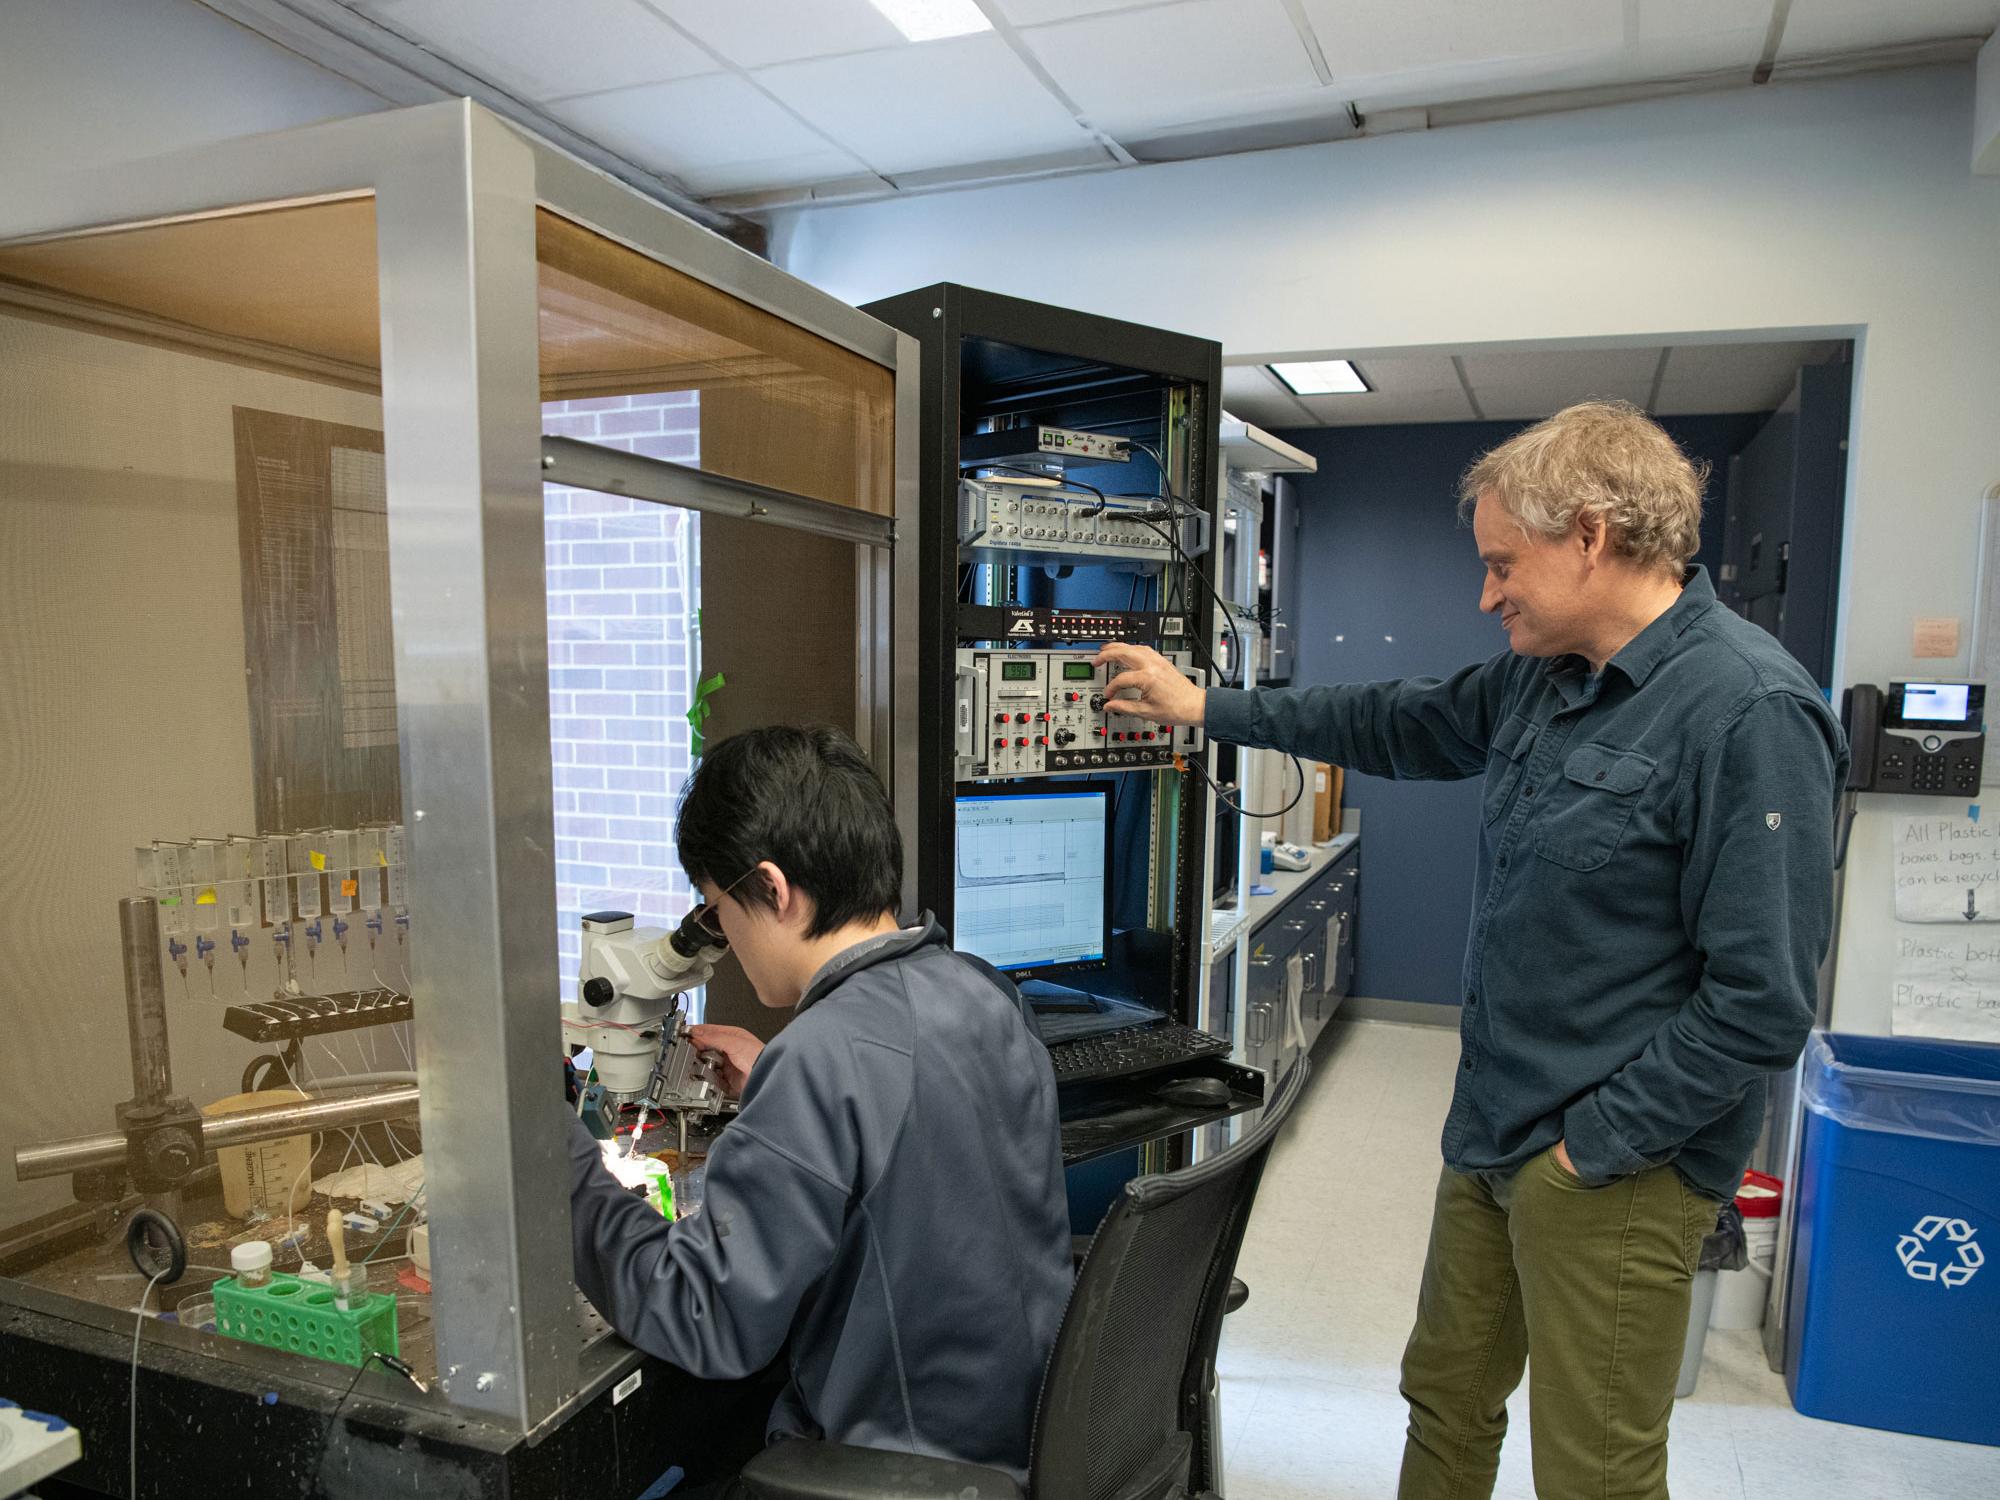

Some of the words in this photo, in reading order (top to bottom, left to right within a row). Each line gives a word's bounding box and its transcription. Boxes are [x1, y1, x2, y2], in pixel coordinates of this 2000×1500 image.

[1905, 823, 1929, 841] All
[1939, 821, 1992, 841] Plastic
[1899, 875, 1928, 888] can
[1934, 871, 1950, 885] be
[1902, 938, 1956, 960] Plastic
[1015, 970, 1032, 978] DELL
[1896, 983, 1961, 1009] Plastic
[244, 1151, 256, 1187] NALGENE
